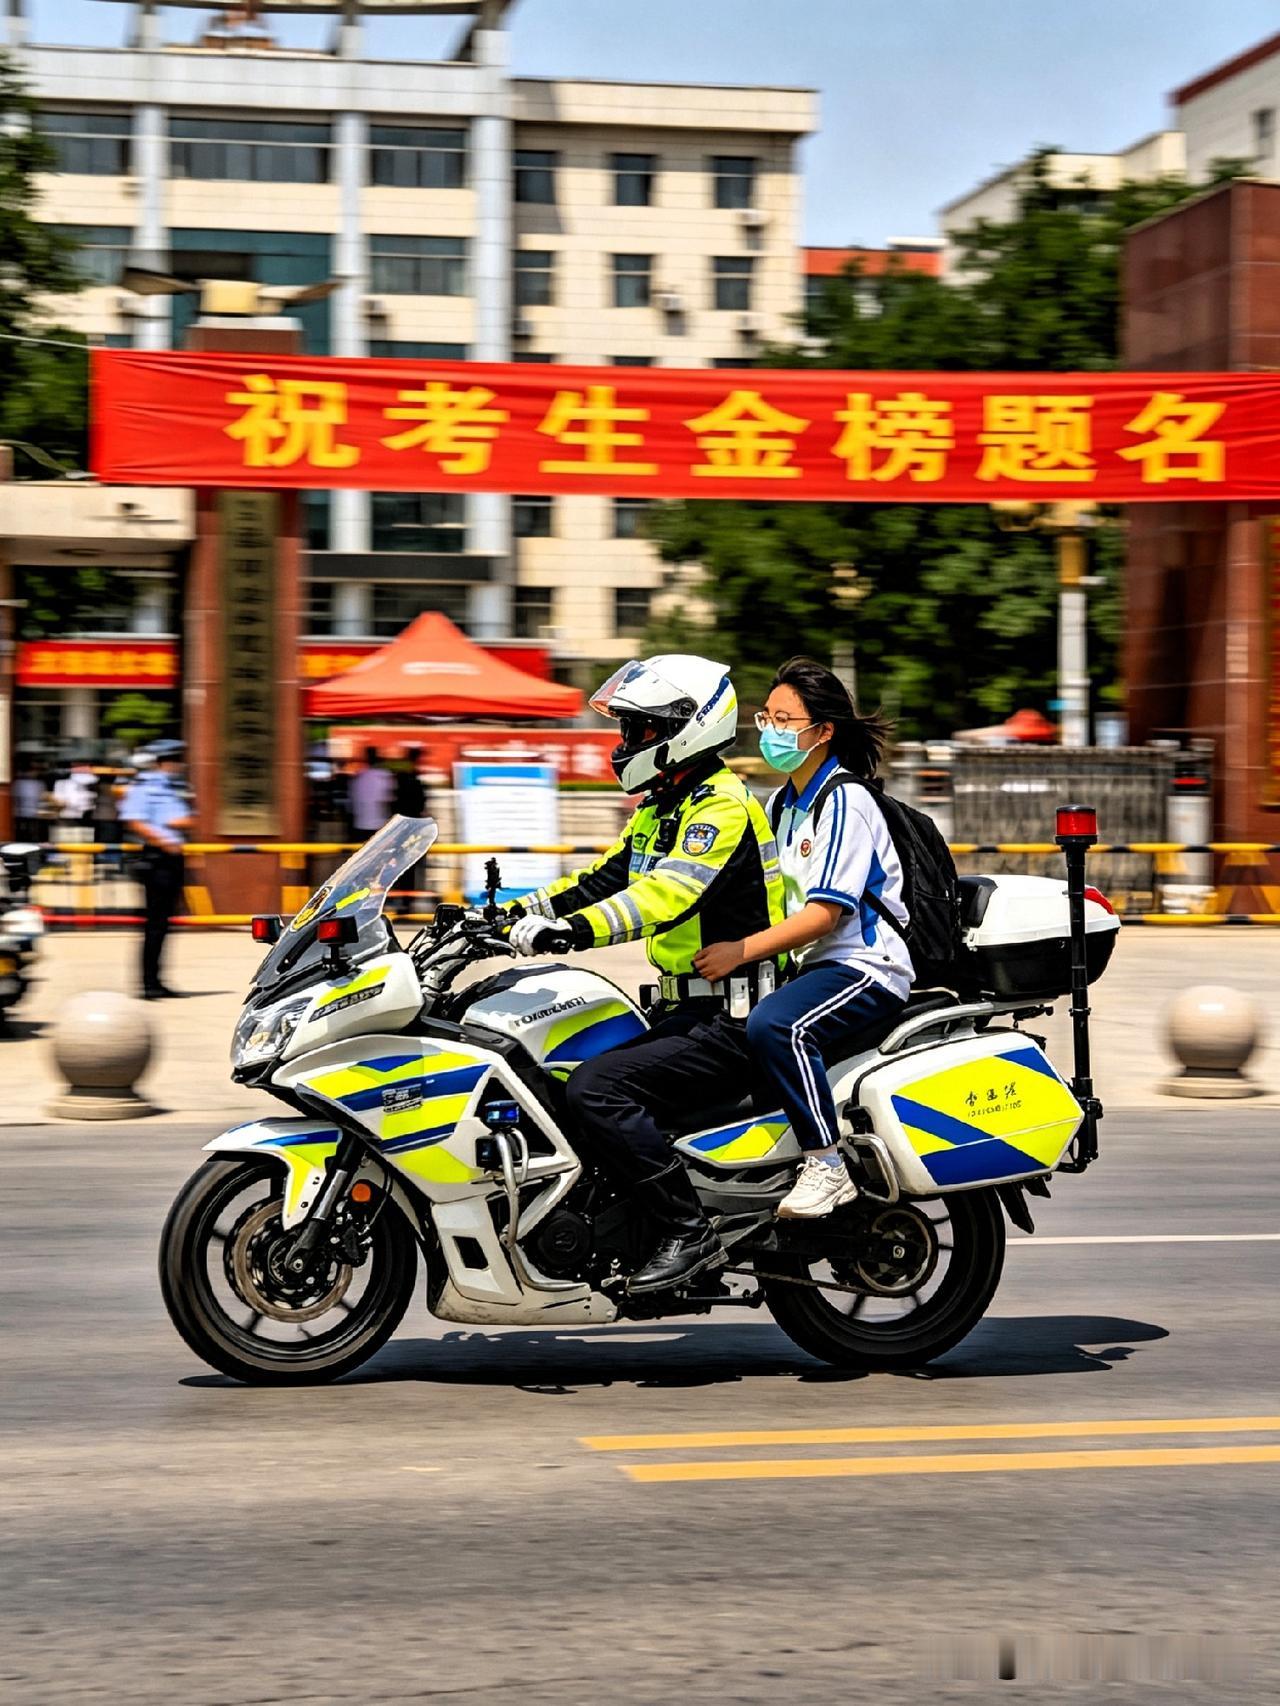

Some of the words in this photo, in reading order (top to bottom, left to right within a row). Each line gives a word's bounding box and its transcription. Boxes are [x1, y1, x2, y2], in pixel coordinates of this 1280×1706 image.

[226, 375, 1226, 483] 祝考生金榜题名
